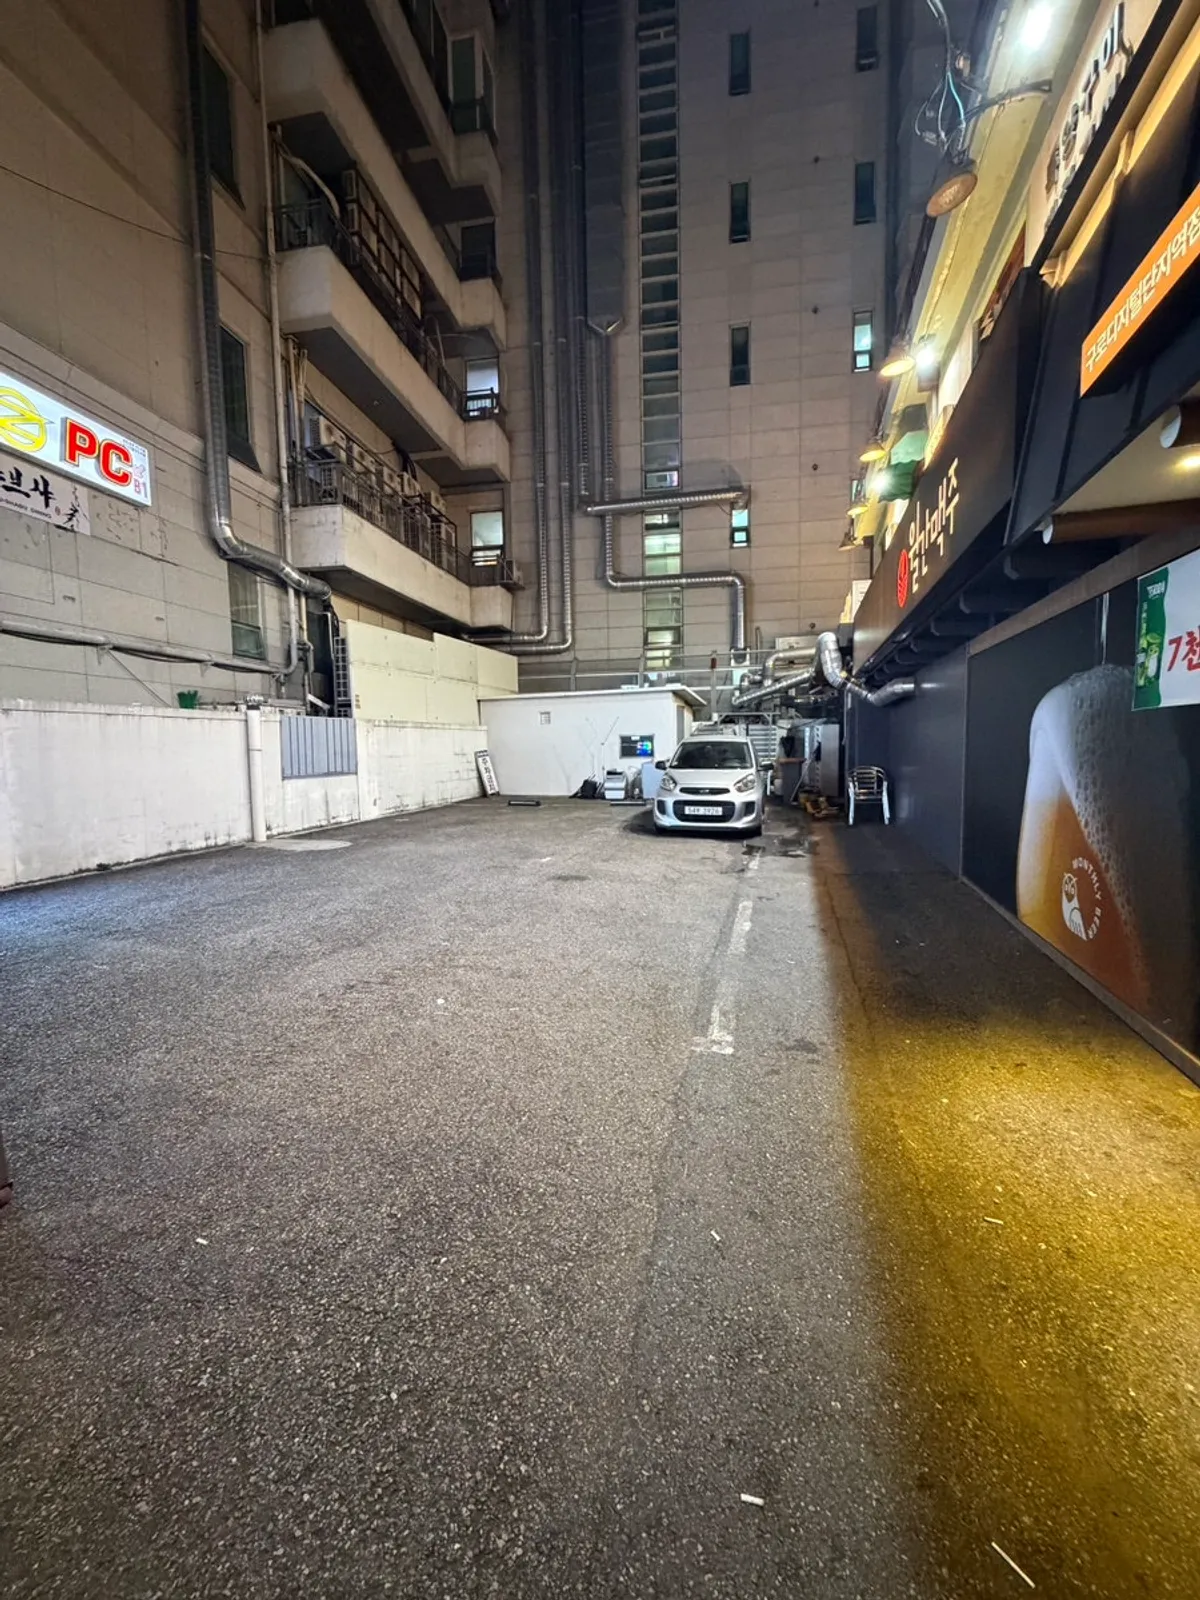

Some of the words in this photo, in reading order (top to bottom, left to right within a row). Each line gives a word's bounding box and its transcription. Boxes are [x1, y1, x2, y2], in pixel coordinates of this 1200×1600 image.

[65, 418, 133, 486] PC
[907, 457, 959, 594] 월간맥주
[1071, 857, 1102, 901] MONTHLY
[1087, 906, 1102, 940] BEER
